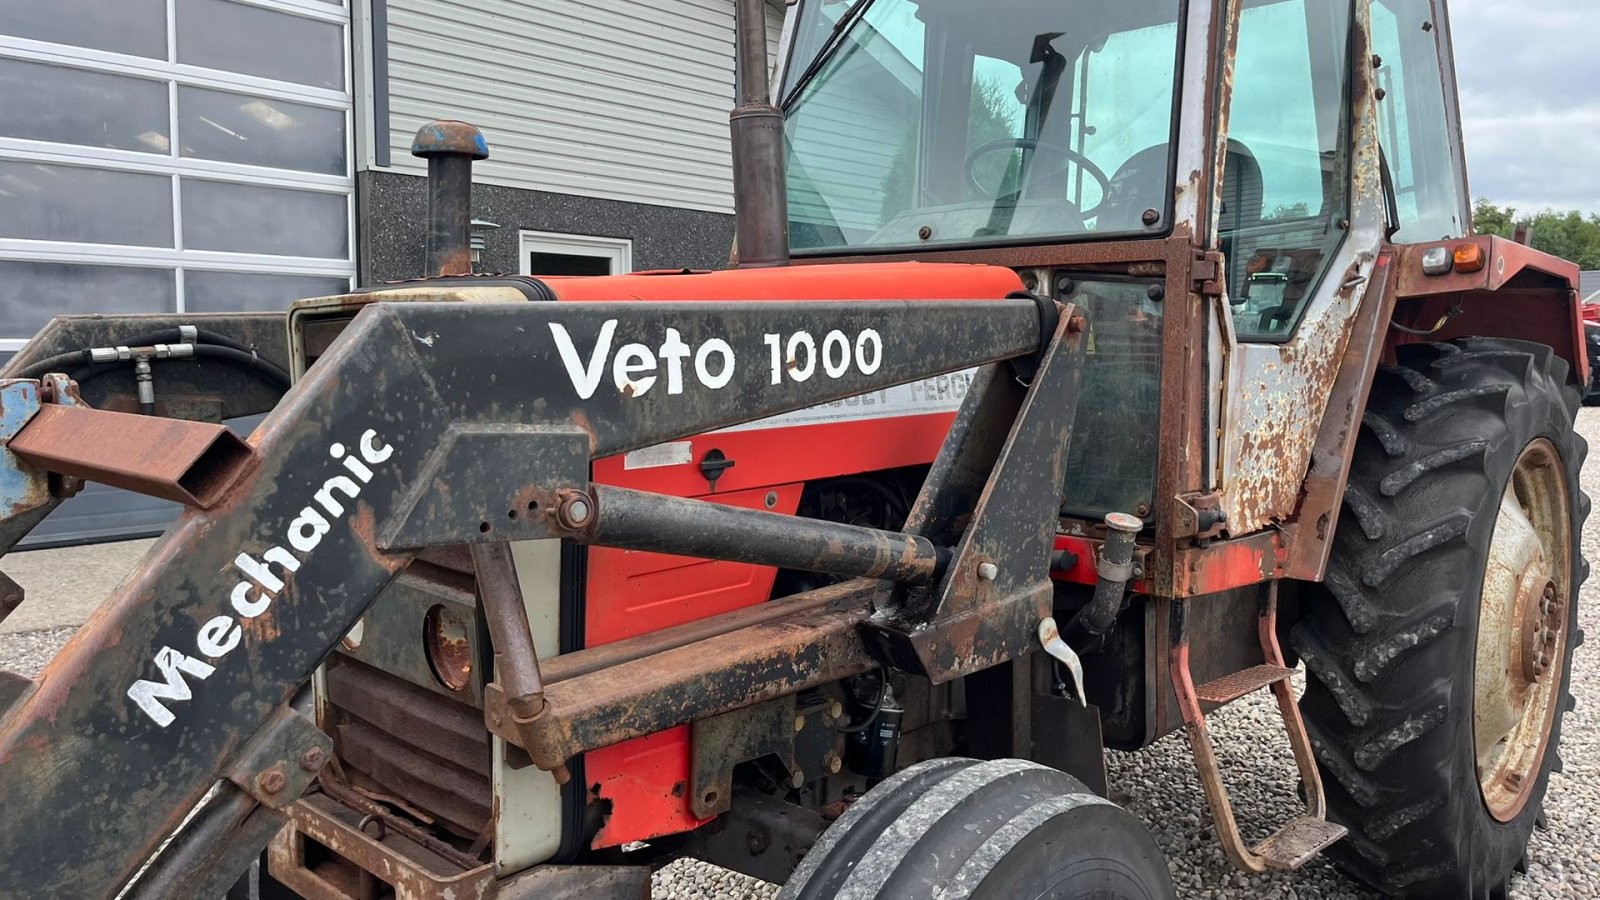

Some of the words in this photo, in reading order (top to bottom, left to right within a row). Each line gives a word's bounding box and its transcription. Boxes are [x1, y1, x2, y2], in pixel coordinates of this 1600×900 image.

[547, 318, 736, 400] Veto
[764, 327, 883, 386] 1000
[127, 428, 394, 728] Mechanic
